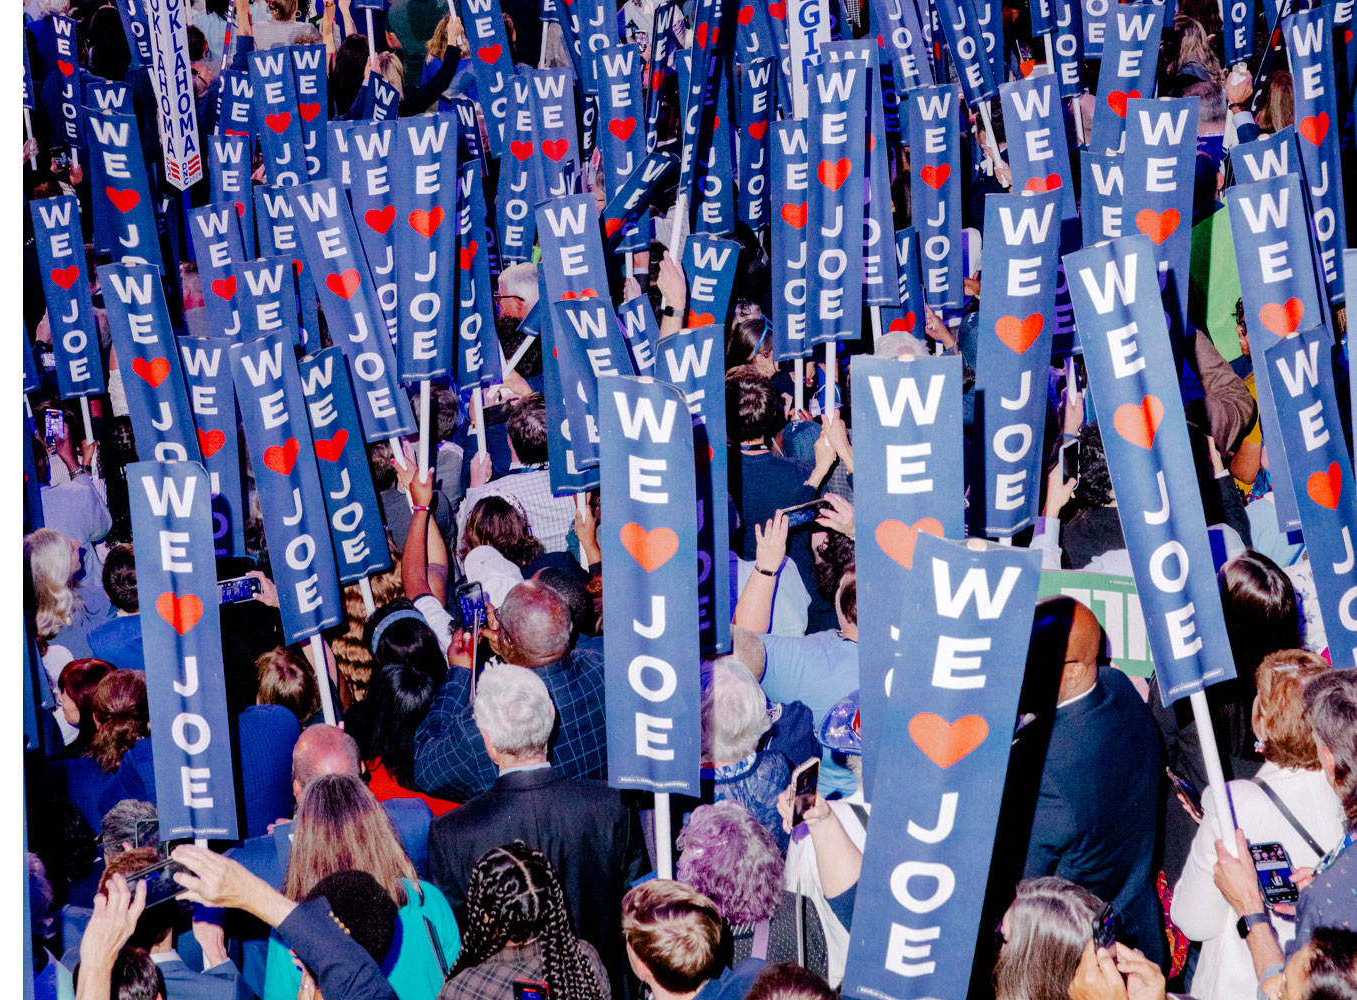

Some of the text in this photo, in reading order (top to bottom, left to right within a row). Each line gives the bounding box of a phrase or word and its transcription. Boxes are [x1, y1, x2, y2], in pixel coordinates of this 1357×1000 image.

[602, 51, 633, 108] WE
[1057, 5, 1079, 84] JOE
[1116, 14, 1155, 77] WE
[90, 116, 128, 178] WE
[817, 69, 856, 320] WE JOE
[917, 92, 951, 293] WE JOE
[1138, 109, 1189, 192] WE
[1292, 19, 1337, 283] WE JOE
[39, 202, 90, 382] WE JOE
[109, 273, 158, 344] WE
[297, 187, 396, 418] WE JOE
[408, 122, 449, 359] WE JOE
[544, 204, 589, 276] WE
[1239, 188, 1292, 284] WE
[869, 375, 943, 495] WE
[992, 202, 1054, 510] WE JOE
[1275, 341, 1330, 452] WE
[241, 342, 324, 614] WE JOE
[302, 356, 369, 564] WE JOE
[613, 391, 677, 504] WE
[1079, 253, 1146, 380] WE
[1144, 470, 1202, 660] JOE
[141, 476, 197, 573] WE
[170, 656, 214, 808] JOE
[627, 596, 677, 760] JOE
[930, 557, 1020, 690] WE
[884, 792, 959, 977] JOE
